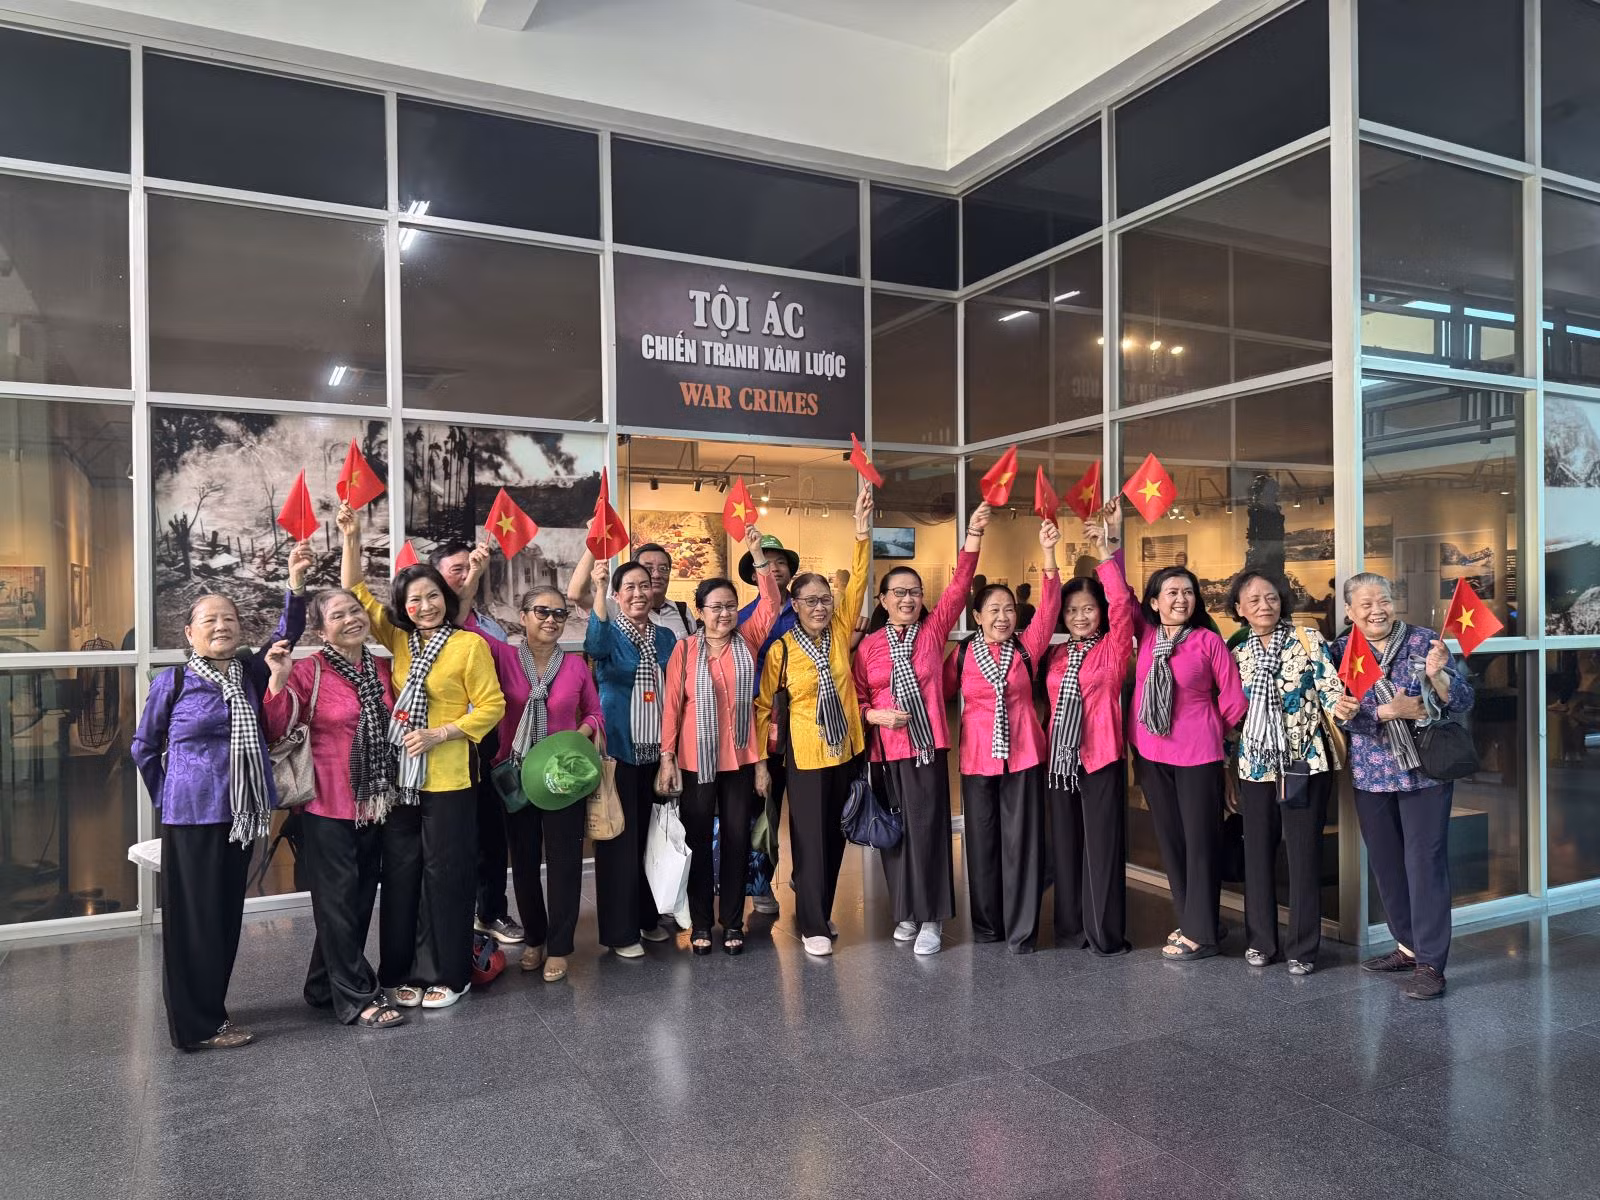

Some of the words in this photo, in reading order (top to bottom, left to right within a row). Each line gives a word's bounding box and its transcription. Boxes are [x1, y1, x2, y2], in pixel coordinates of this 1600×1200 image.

[688, 284, 750, 338] TỘI
[761, 291, 804, 339] ÁC
[641, 330, 697, 363] CHIẾN
[702, 341, 759, 370] TRANH
[763, 345, 800, 374] XÂM
[805, 350, 846, 381] LƯỢC
[679, 382, 732, 409] WAR
[739, 387, 819, 416] CRIMES
